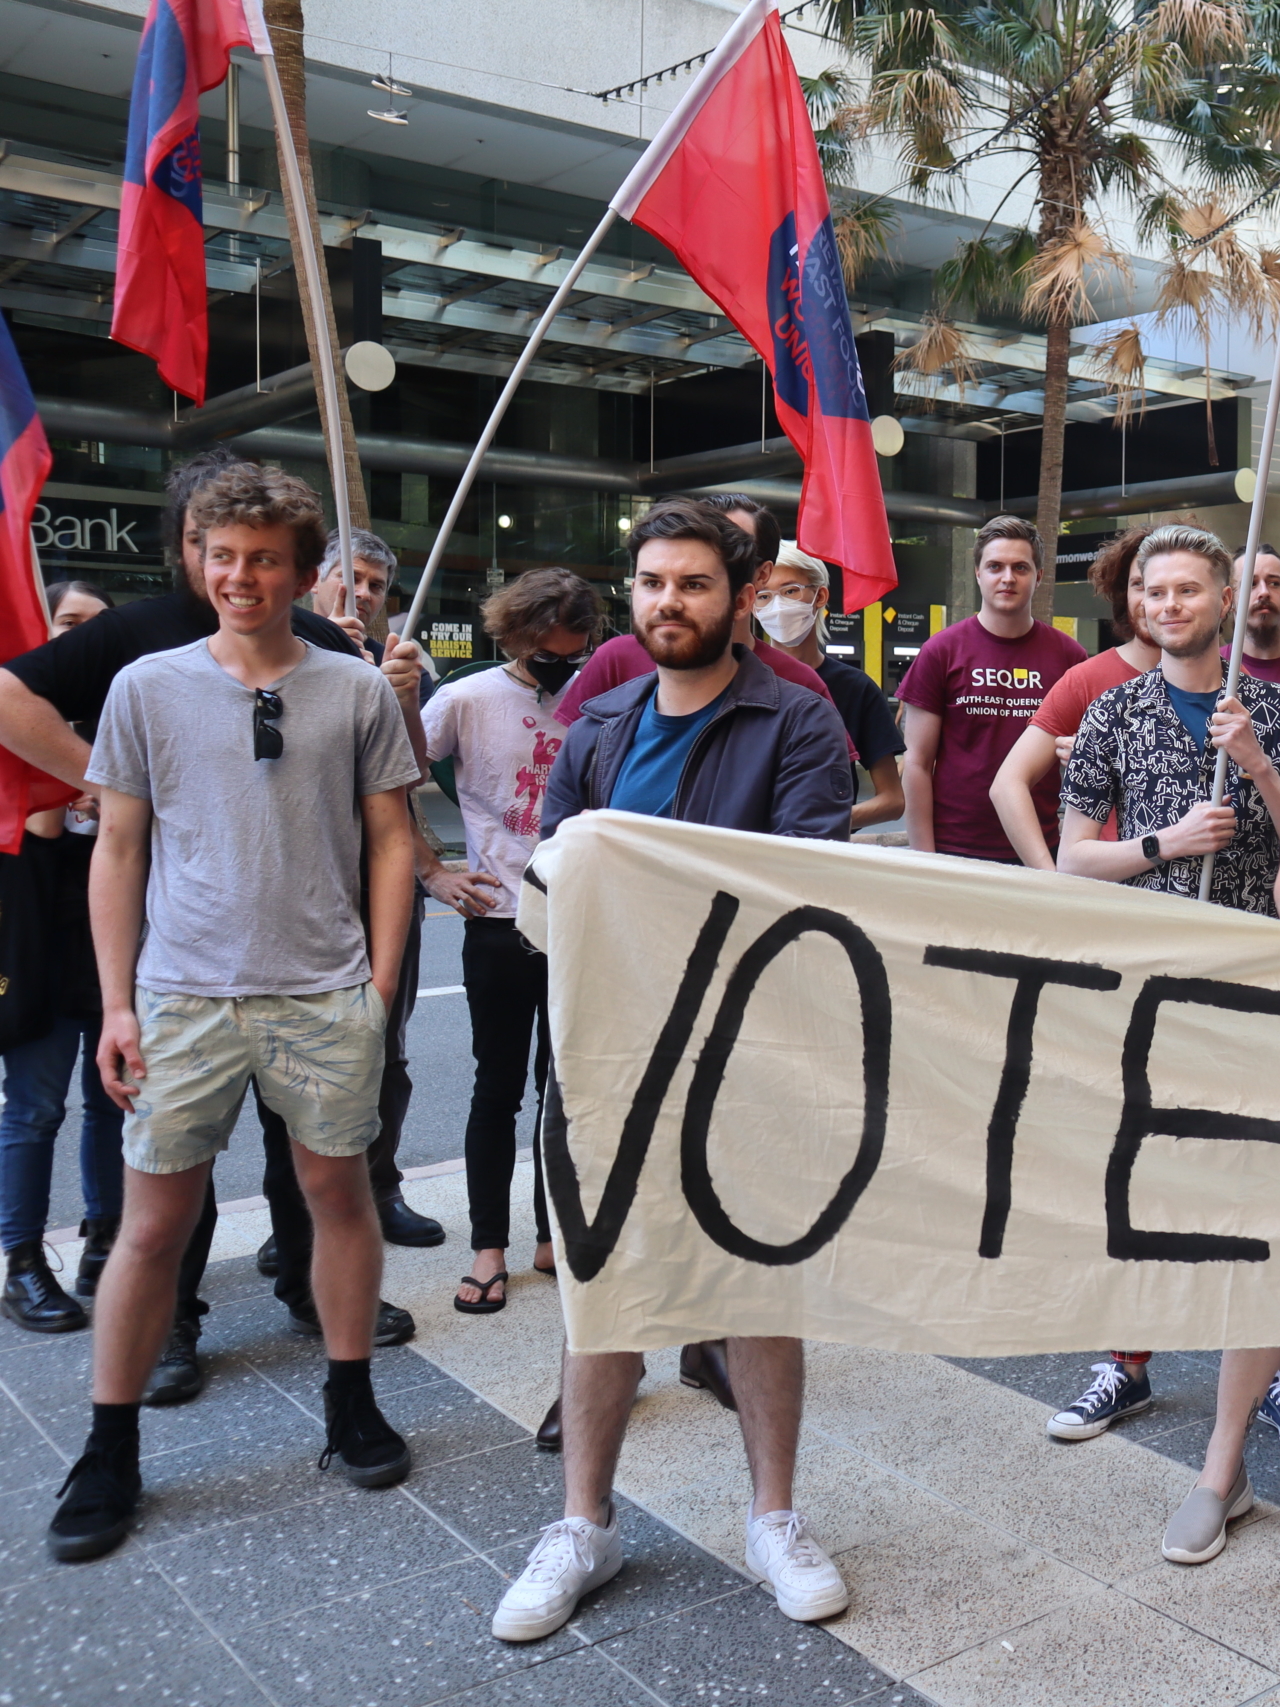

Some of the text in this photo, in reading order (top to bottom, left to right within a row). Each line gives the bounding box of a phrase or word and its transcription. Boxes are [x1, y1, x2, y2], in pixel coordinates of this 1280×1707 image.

[432, 622, 473, 633] COME IN
[421, 631, 473, 641] & TRY OUR
[429, 640, 473, 650] BARISTA
[430, 649, 473, 658] SERVICE
[971, 667, 1044, 689] SEQUR
[1006, 698, 1043, 707] QUEENS
[966, 707, 1036, 718] UNION OF RENT
